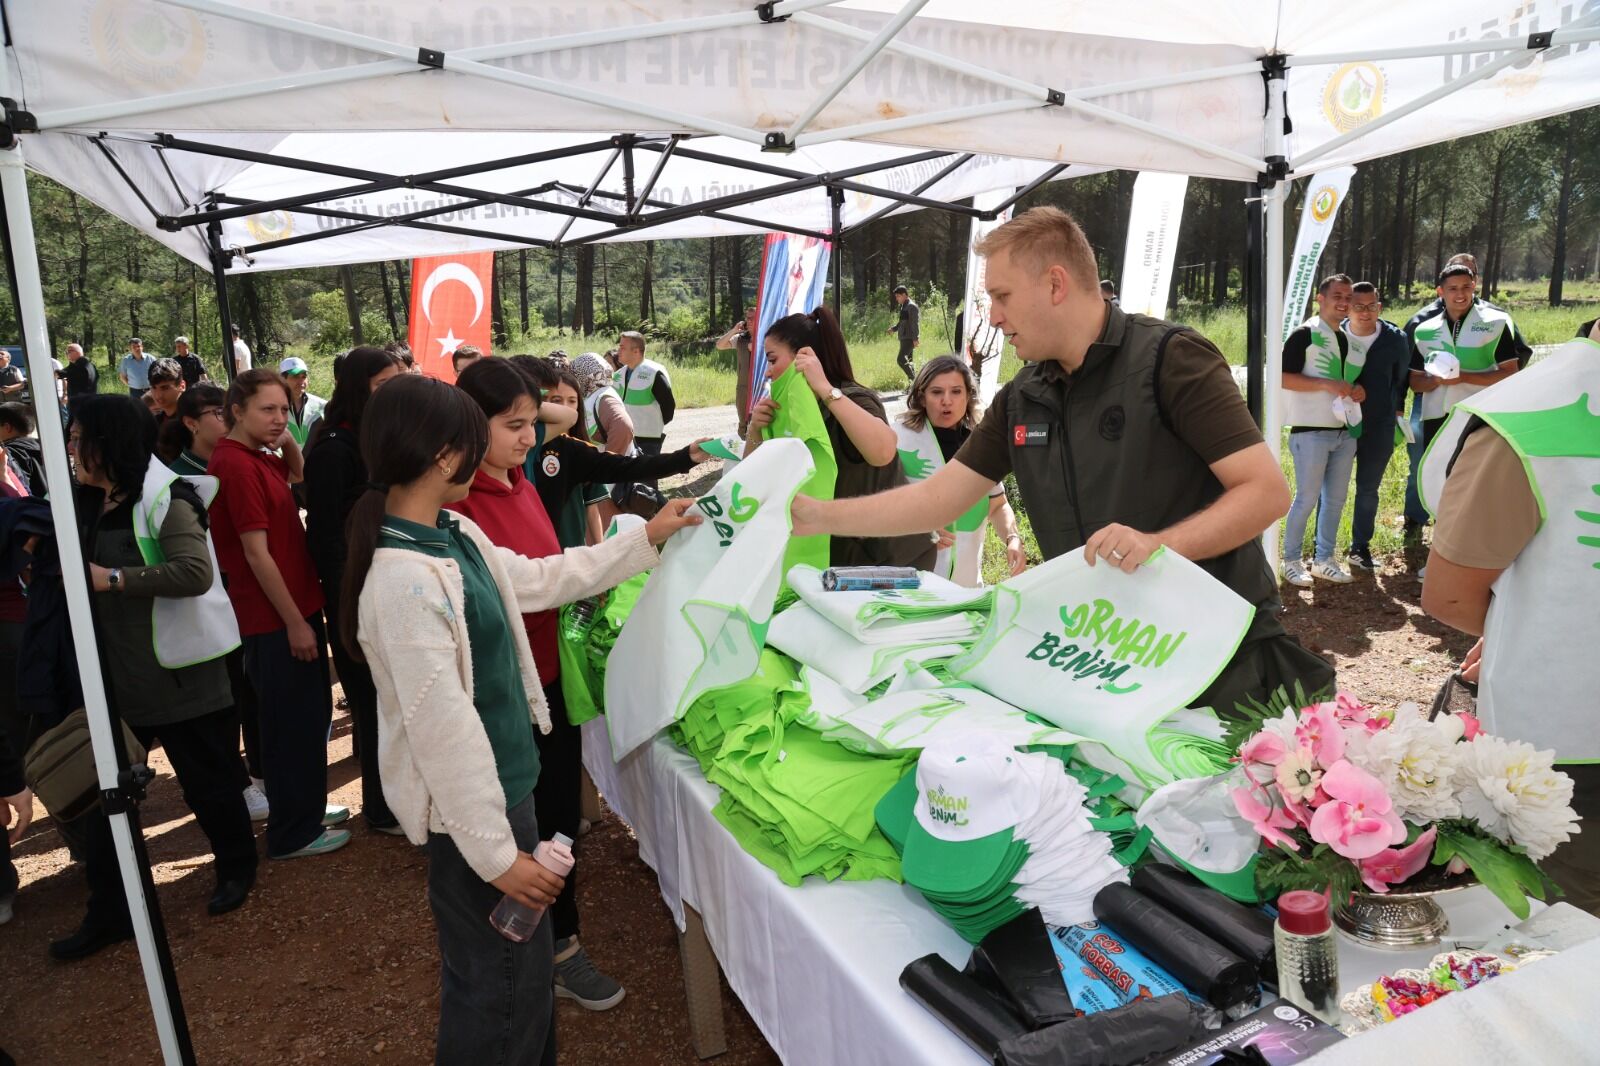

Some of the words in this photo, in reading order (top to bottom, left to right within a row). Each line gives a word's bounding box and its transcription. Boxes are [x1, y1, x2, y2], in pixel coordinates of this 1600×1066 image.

[1143, 230, 1155, 267] ORMAN
[1291, 254, 1308, 299] ORMAN
[1060, 598, 1188, 668] ORMAN
[1079, 941, 1135, 996] TORBASI
